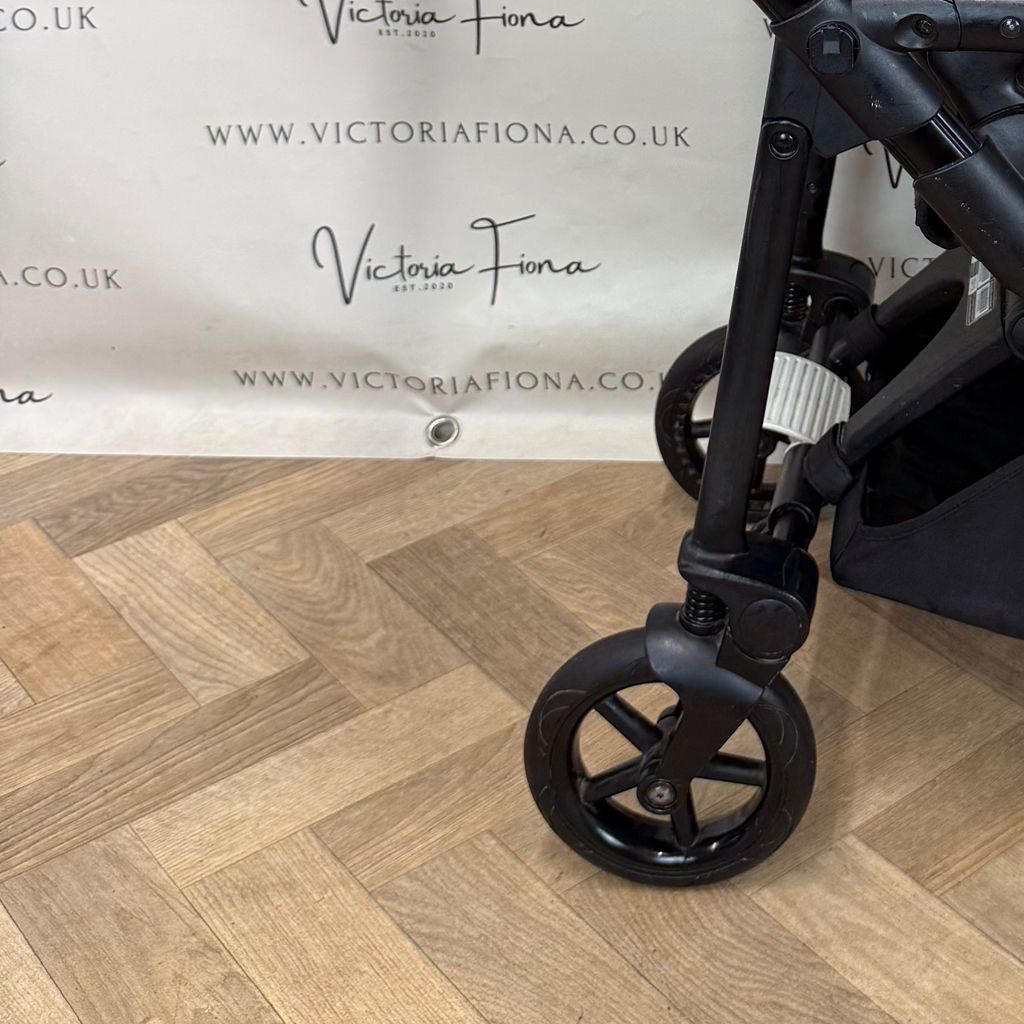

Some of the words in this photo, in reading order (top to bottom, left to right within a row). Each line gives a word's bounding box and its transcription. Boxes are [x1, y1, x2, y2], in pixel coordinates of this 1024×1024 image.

[206, 121, 691, 147] WWW.VICTORIAFIONA.CO.UK
[312, 223, 475, 305] Victoria
[470, 214, 601, 306] Fiona
[233, 370, 664, 396] WWW.VICTORIAFIONA.CO.
